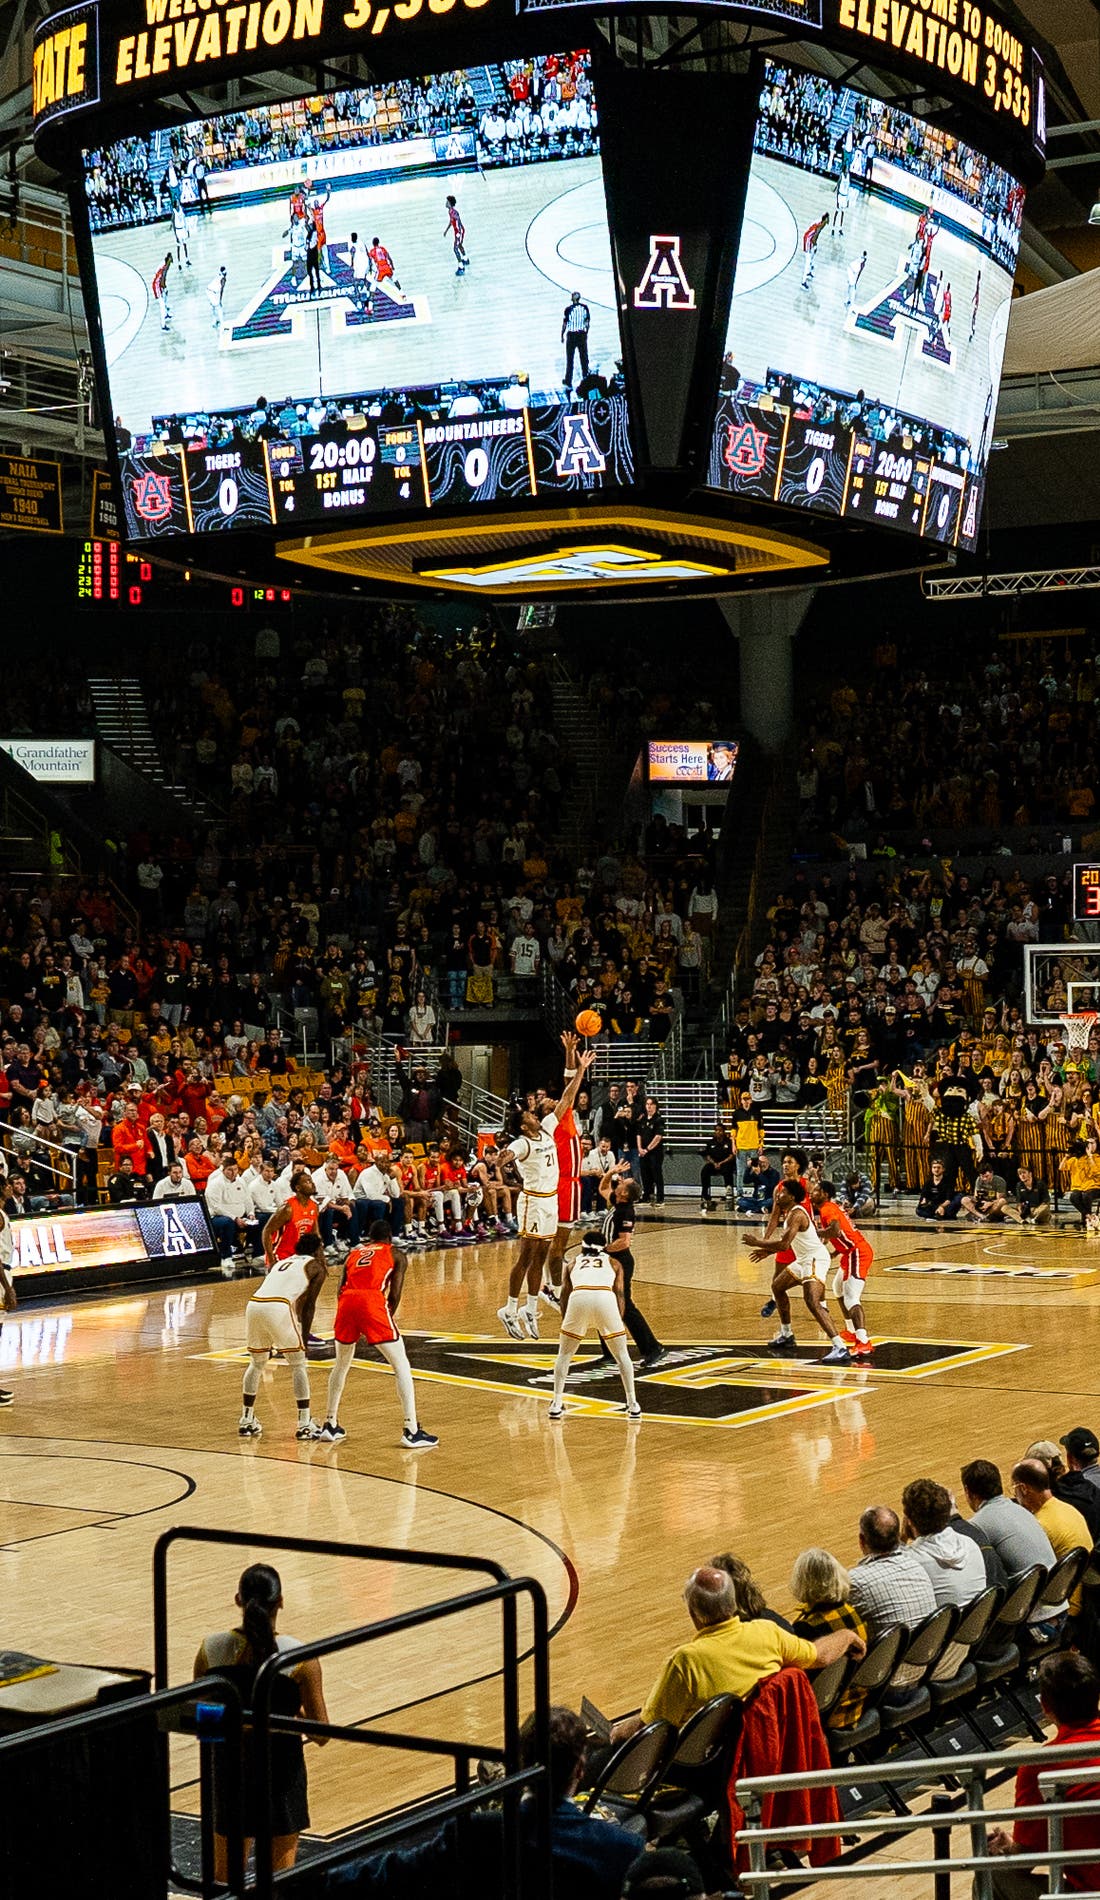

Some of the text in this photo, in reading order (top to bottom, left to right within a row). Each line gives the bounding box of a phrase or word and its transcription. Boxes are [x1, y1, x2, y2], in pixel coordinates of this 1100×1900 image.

[115, 0, 324, 85] ELEVATION
[963, 1, 981, 38] TO
[984, 16, 1023, 74] BOONE
[839, 0, 979, 86] ELEVATION
[984, 54, 1030, 126] 3,333
[424, 417, 524, 444] MOUNTAINEERS
[804, 429, 835, 450] TIGERS
[205, 452, 241, 471] TIGERS
[310, 438, 375, 470] 20:00
[396, 446, 406, 462] 0
[9, 462, 38, 479] NAIA
[280, 461, 290, 477] 0
[464, 448, 489, 487] 0
[806, 457, 825, 493] 0
[875, 450, 912, 483] 20:00
[316, 467, 373, 489] 1ST HALF
[219, 478, 238, 515] 0
[400, 482, 410, 498] 4
[875, 480, 889, 497] 1ST
[284, 495, 295, 511] 4
[323, 489, 365, 508] BONUS
[937, 494, 950, 528] 0
[78, 565, 92, 575] 21
[141, 564, 151, 580] 0
[78, 576, 92, 586] 23
[78, 587, 92, 598] 24
[129, 586, 142, 605] 0
[231, 588, 243, 606] 0
[254, 590, 264, 600] 12
[16, 746, 88, 758] Grandfather
[649, 743, 689, 753] Success
[22, 759, 80, 771] Mountain
[649, 753, 706, 764] Starts Here.
[521, 943, 534, 958] 15
[545, 1154, 555, 1168] 21
[160, 1203, 196, 1257] A
[12, 1224, 72, 1268] ALL
[356, 1250, 375, 1268] 2
[580, 1258, 603, 1270] 23
